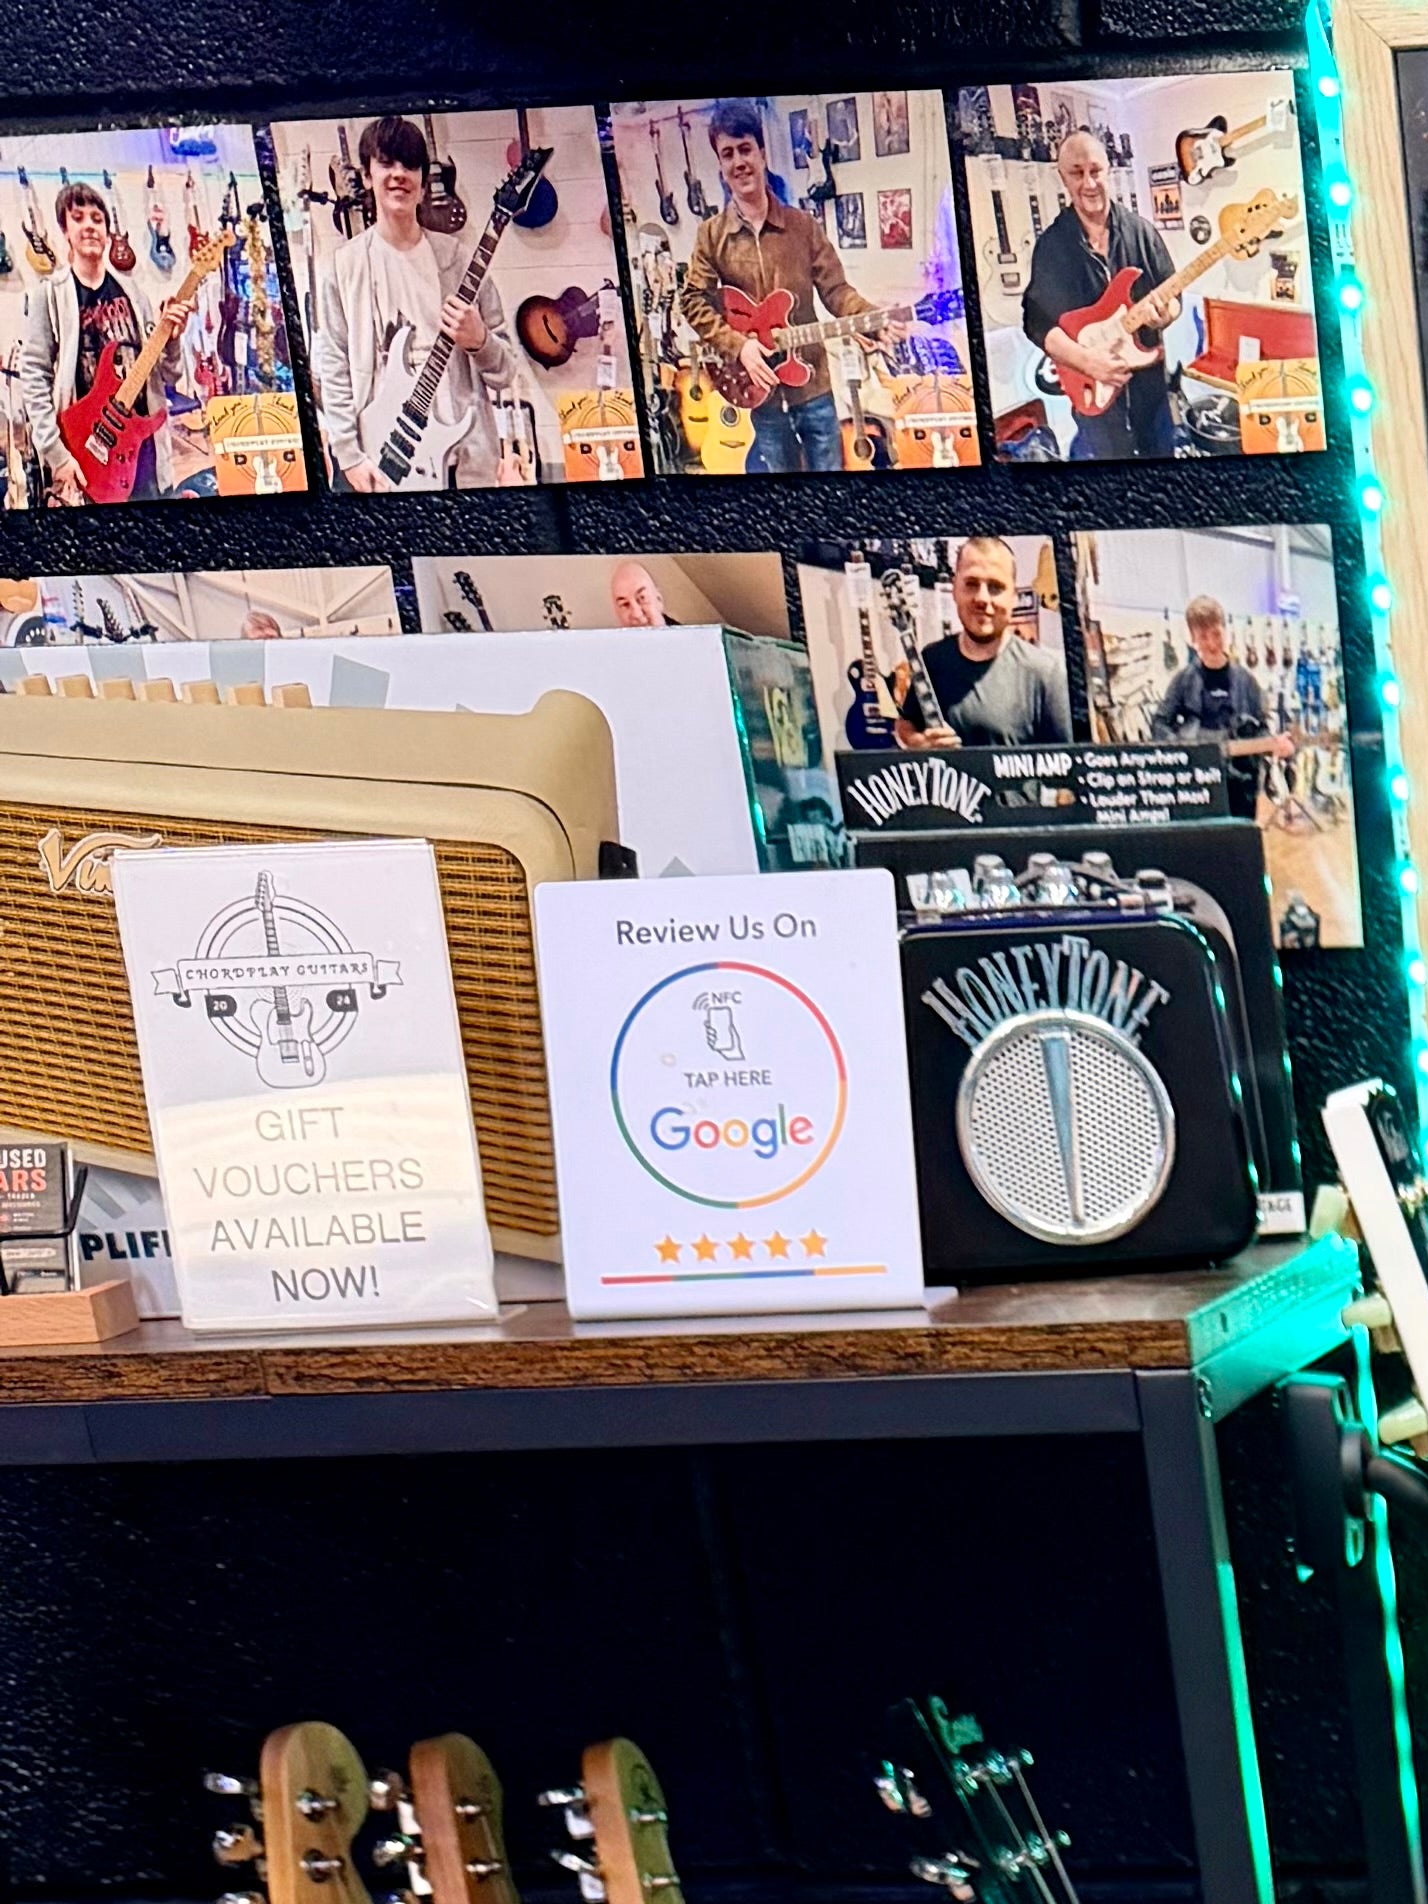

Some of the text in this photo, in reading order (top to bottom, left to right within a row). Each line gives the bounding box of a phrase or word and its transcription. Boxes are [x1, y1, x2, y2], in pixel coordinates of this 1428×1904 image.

[847, 756, 992, 826] HONEYTONE
[616, 912, 817, 945] Review Us On
[185, 962, 369, 982] CHORDPLAY GUITARS
[711, 991, 743, 1005] NFC
[922, 936, 1170, 1053] HONEYTONE
[684, 1069, 773, 1089] TAP HERE
[254, 1106, 345, 1142] GIFT
[650, 1103, 815, 1160] Google
[193, 1158, 424, 1199] VOUCHERS
[211, 1211, 427, 1251] AVAILABLE
[271, 1264, 380, 1302] NOW!
